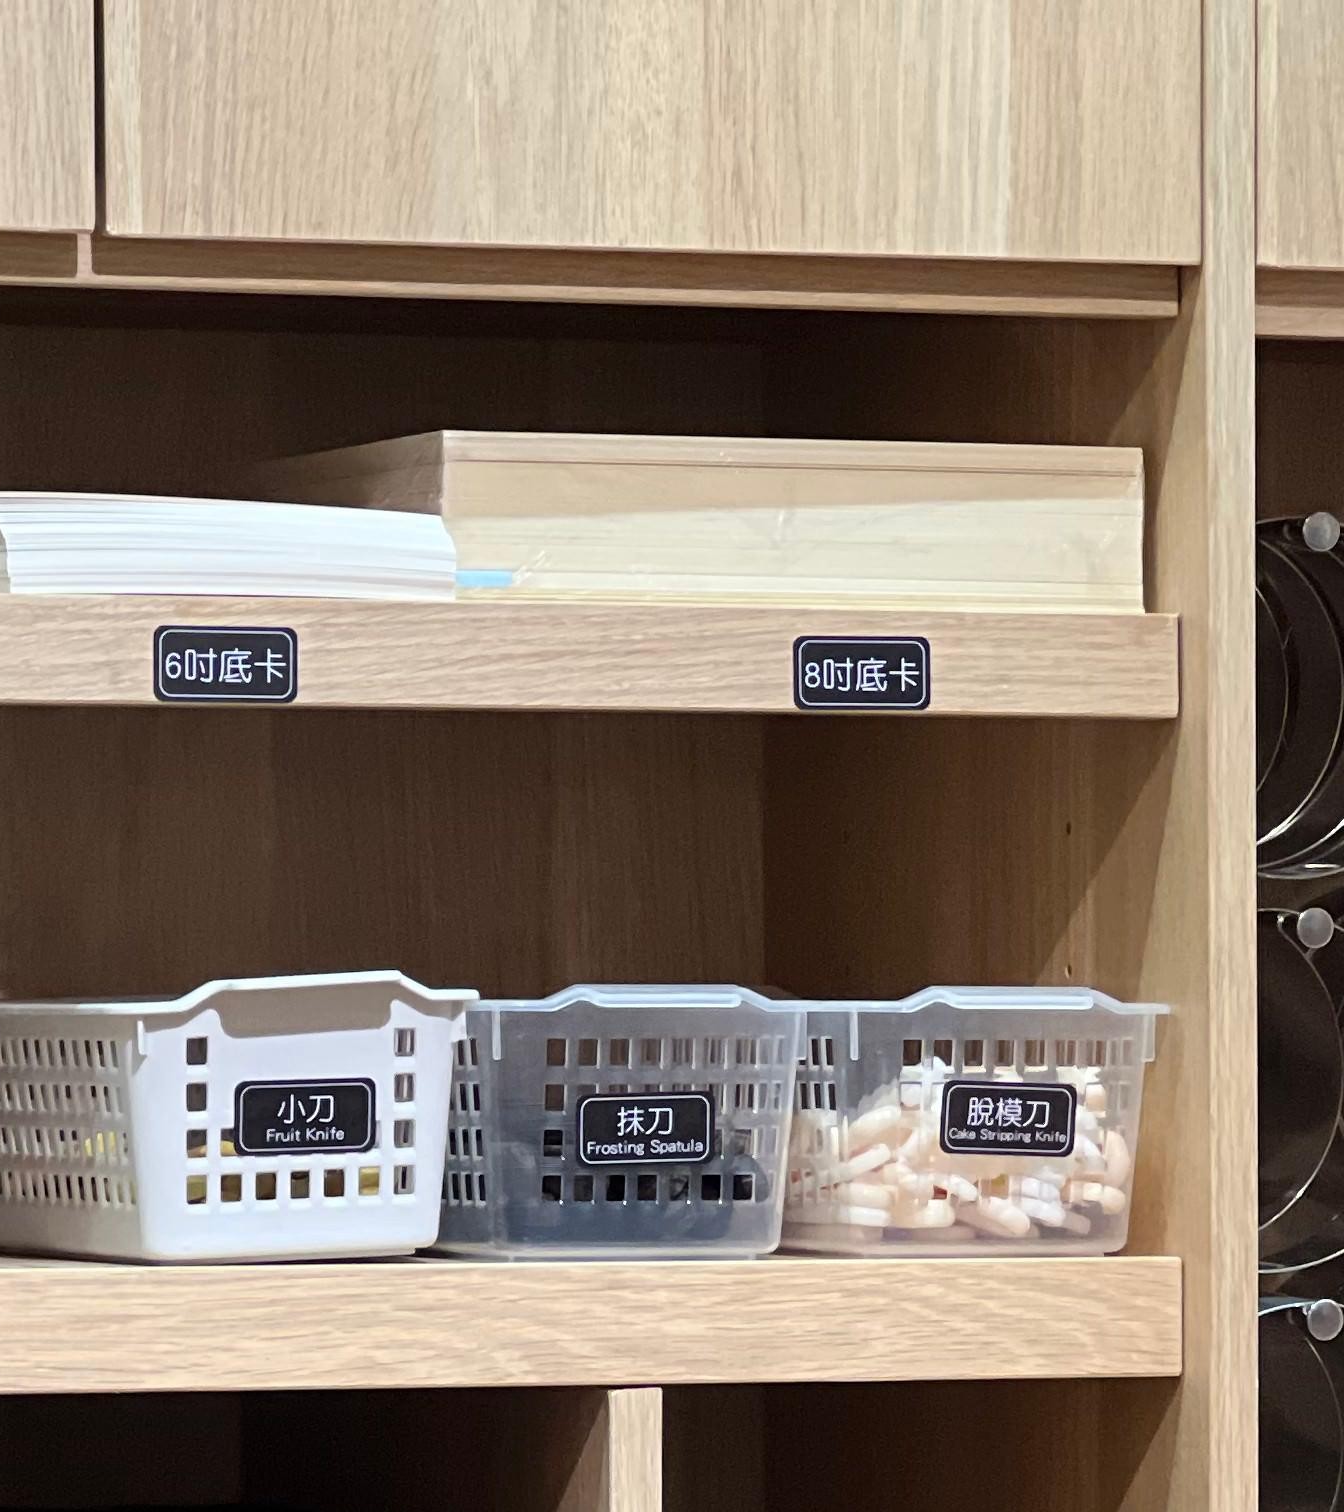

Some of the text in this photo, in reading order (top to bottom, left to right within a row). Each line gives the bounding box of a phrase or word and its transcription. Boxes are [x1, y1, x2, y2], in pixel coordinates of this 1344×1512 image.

[166, 648, 287, 683] 6吋底卡
[805, 657, 919, 691] 8吋底卡
[277, 1094, 334, 1124] 小刀
[617, 1106, 673, 1136] 抹刀
[266, 1126, 345, 1142] Fruit Knife
[587, 1139, 704, 1156] Frosting Spatula
[949, 1127, 1067, 1143] Cake Stripping Knife
